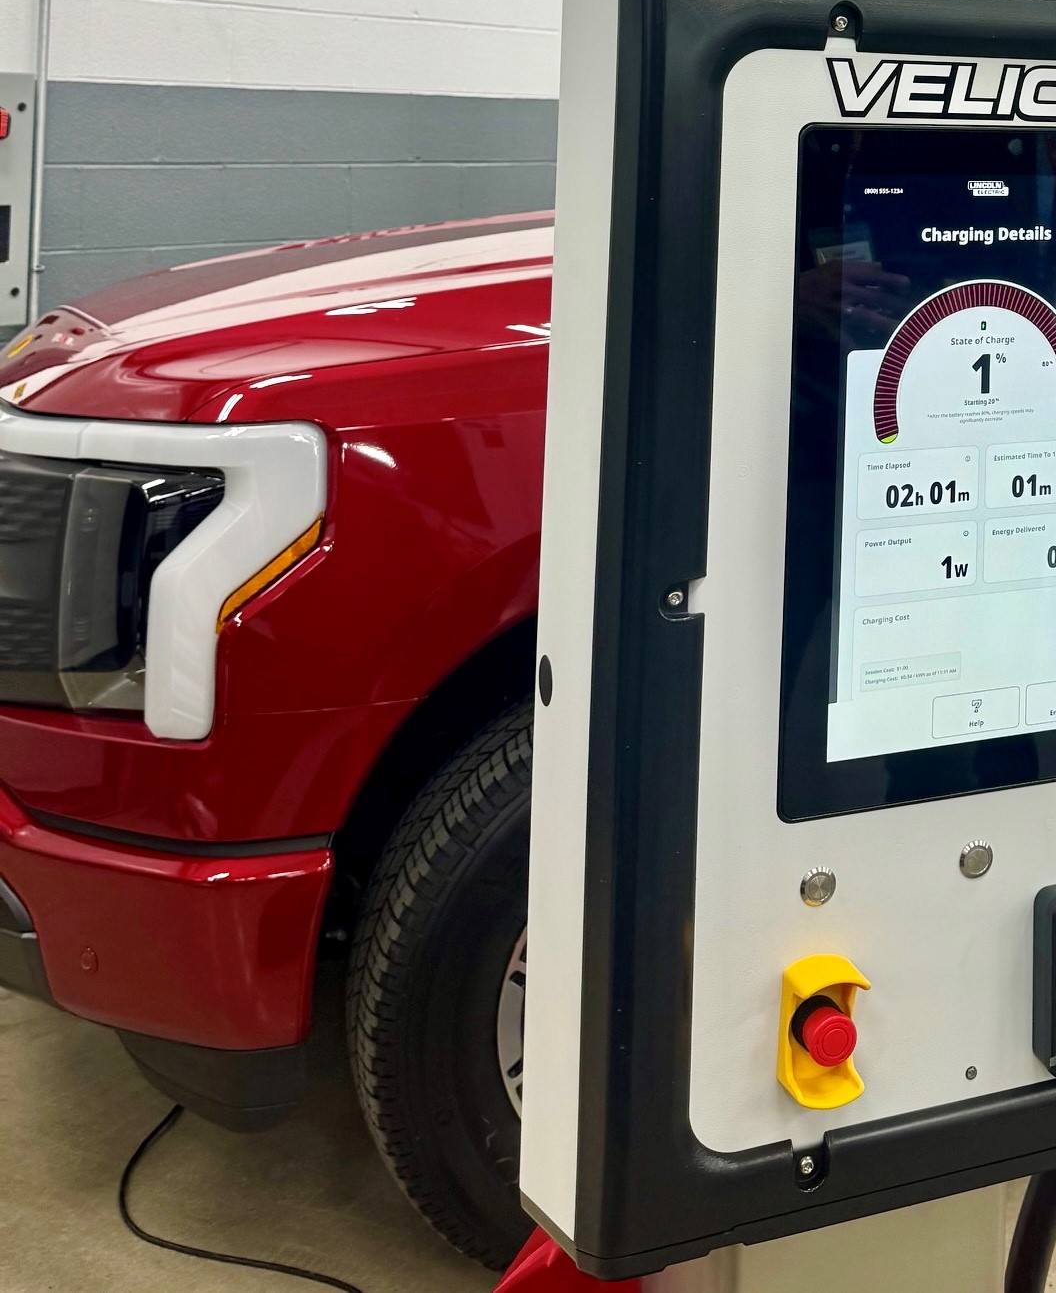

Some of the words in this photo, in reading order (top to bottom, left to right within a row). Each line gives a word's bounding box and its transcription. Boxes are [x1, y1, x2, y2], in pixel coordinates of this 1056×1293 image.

[921, 226, 994, 245] Charging
[998, 226, 1052, 241] Details
[950, 337, 973, 346] State
[975, 336, 984, 345] of
[985, 335, 1015, 345] Charge
[964, 398, 988, 406] Starting
[994, 453, 1026, 462] Estimated
[885, 461, 911, 471] Elapsed
[1011, 473, 1052, 498] 01m
[886, 483, 924, 509] 02h
[929, 480, 970, 505] 01m
[992, 528, 1014, 537] Energy
[1015, 525, 1046, 534] Delivered
[864, 540, 886, 548] Power
[888, 538, 912, 546] Output
[862, 615, 894, 626] Charging
[894, 614, 910, 622] Cost
[968, 719, 985, 728] Help
